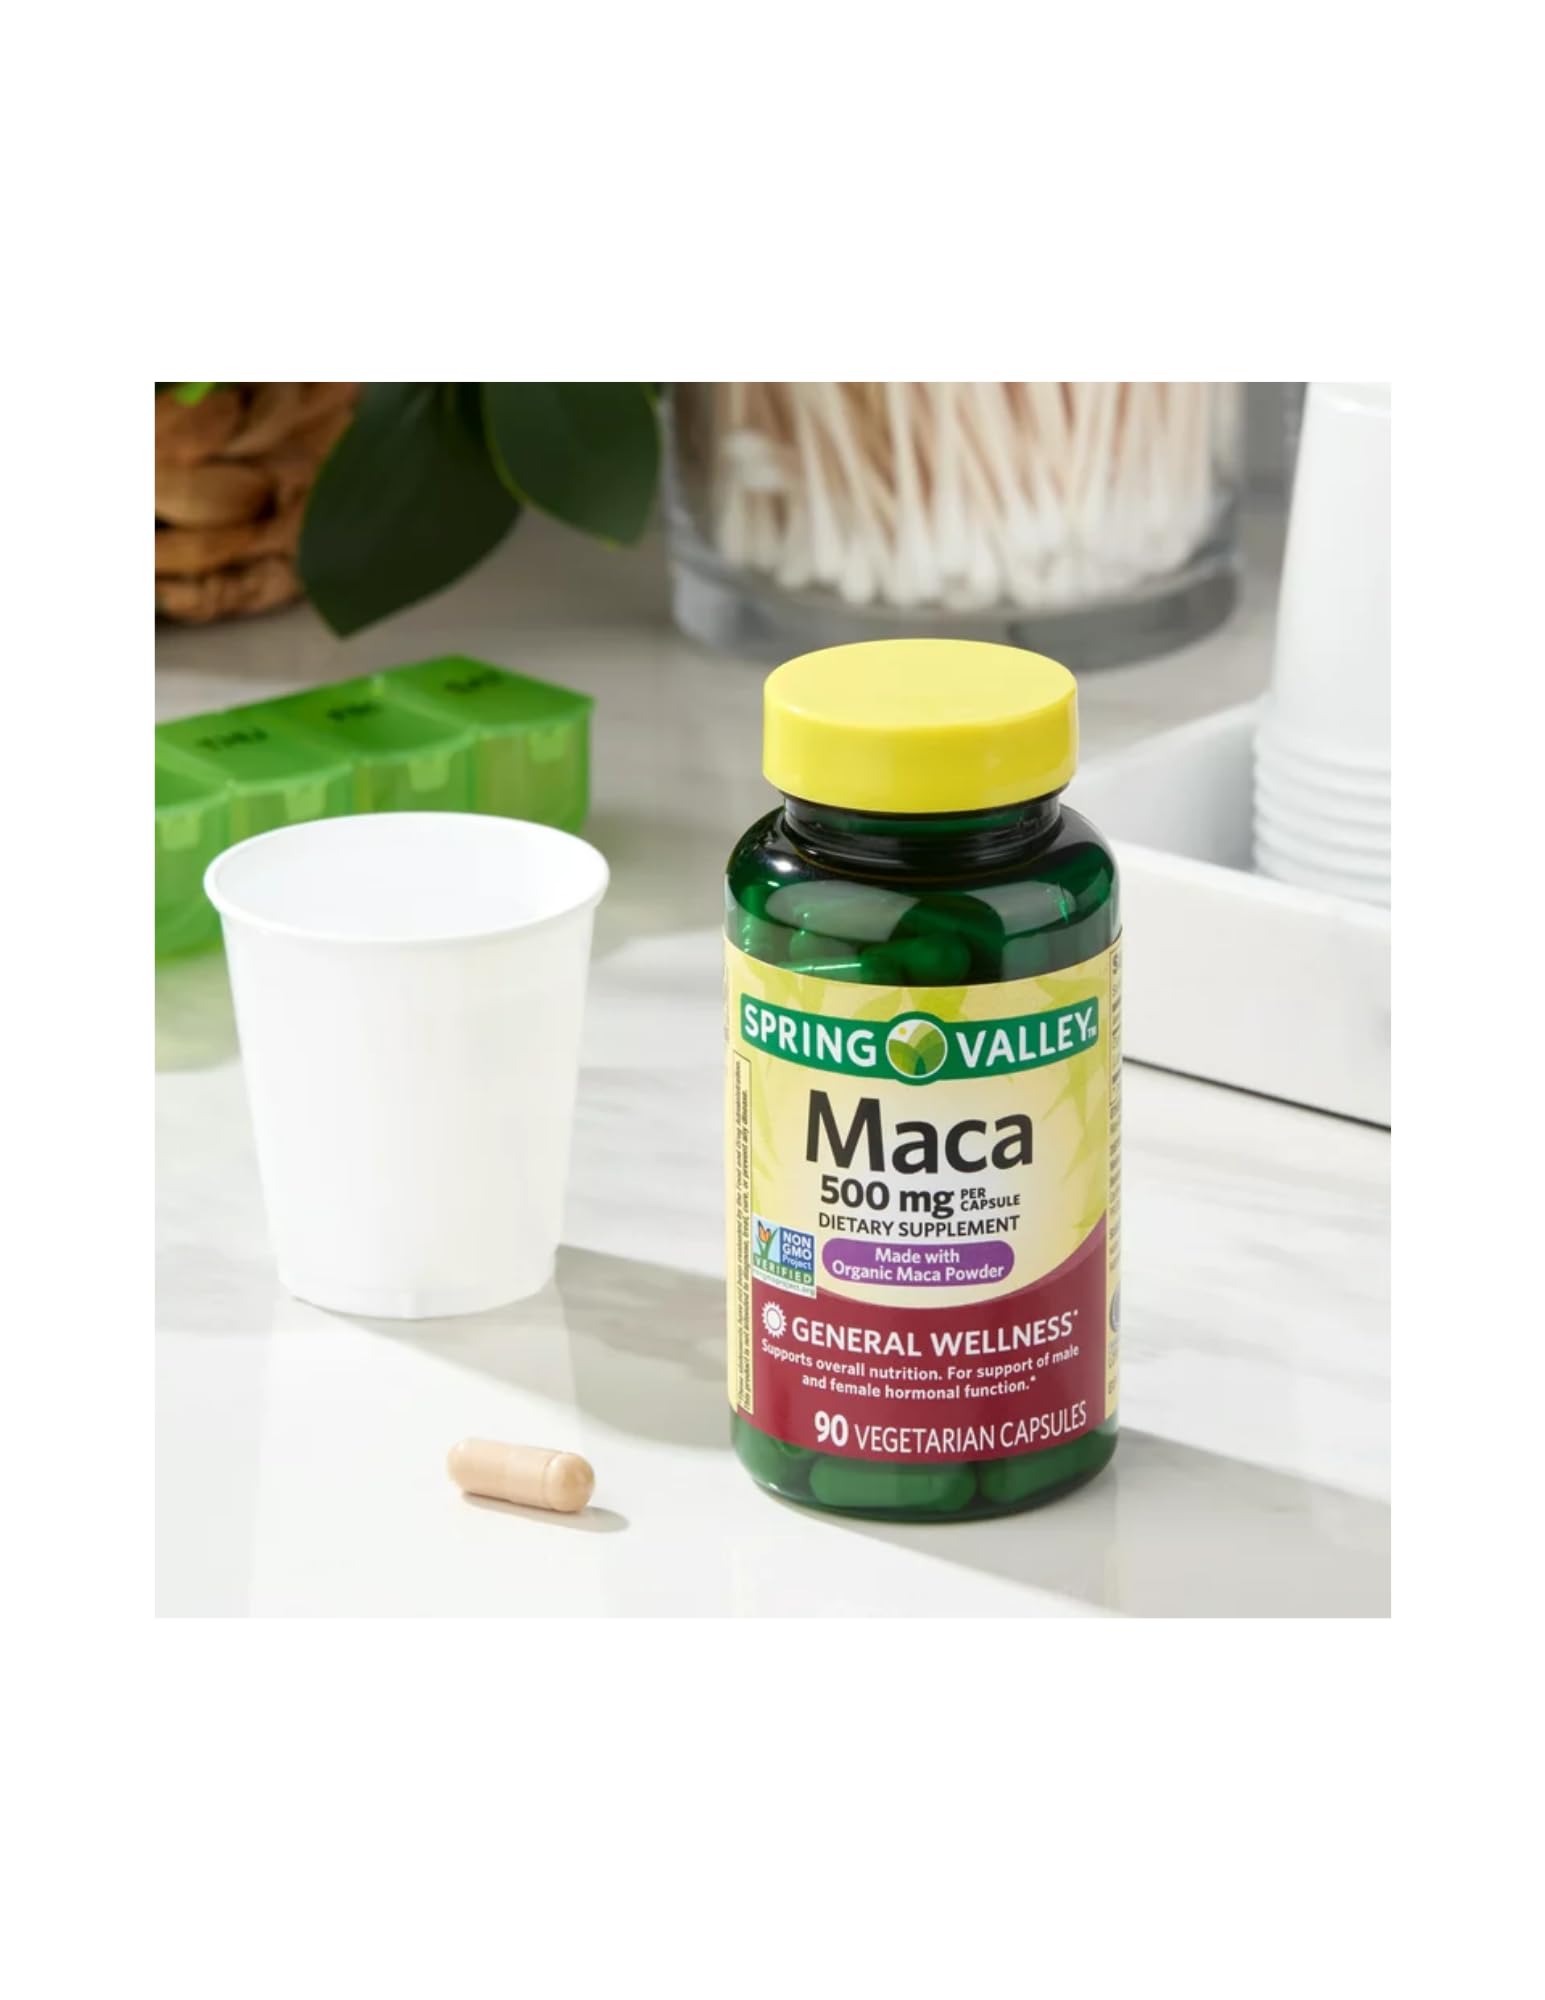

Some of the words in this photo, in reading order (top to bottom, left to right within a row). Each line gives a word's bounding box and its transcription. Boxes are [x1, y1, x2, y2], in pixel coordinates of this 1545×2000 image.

[744, 1003, 877, 1067] SPRING
[956, 1006, 1093, 1068] VALLEY
[806, 1089, 1033, 1175] Maca
[820, 1174, 890, 1210] 500
[900, 1189, 955, 1219] mg
[960, 1187, 986, 1200] PER
[960, 1194, 1021, 1211] CAPSULE
[818, 1212, 894, 1236] DIETARY
[898, 1215, 1020, 1237] SUPPLEMENT
[782, 1230, 812, 1249] NON
[782, 1243, 812, 1260] GMO
[875, 1247, 921, 1264] Made
[925, 1248, 960, 1263] with
[753, 1255, 812, 1285] VERIFIED
[832, 1260, 893, 1280] Organic
[897, 1266, 941, 1281] Maca
[945, 1264, 1004, 1279] Powder
[792, 1312, 922, 1357] GENERAL
[761, 1338, 813, 1366] Supports
[816, 1360, 864, 1376] overall
[869, 1366, 943, 1381] nutrition.
[947, 1366, 973, 1380] For
[977, 1357, 1033, 1378] support
[1036, 1352, 1049, 1367] of
[1052, 1344, 1080, 1364] male
[802, 1374, 827, 1389] and
[830, 1377, 881, 1398] female
[885, 1384, 960, 1400] hormonal
[814, 1410, 849, 1448] 90
[855, 1423, 995, 1454] VEGETARIAN
[1000, 1400, 1088, 1448] CAPSULES
